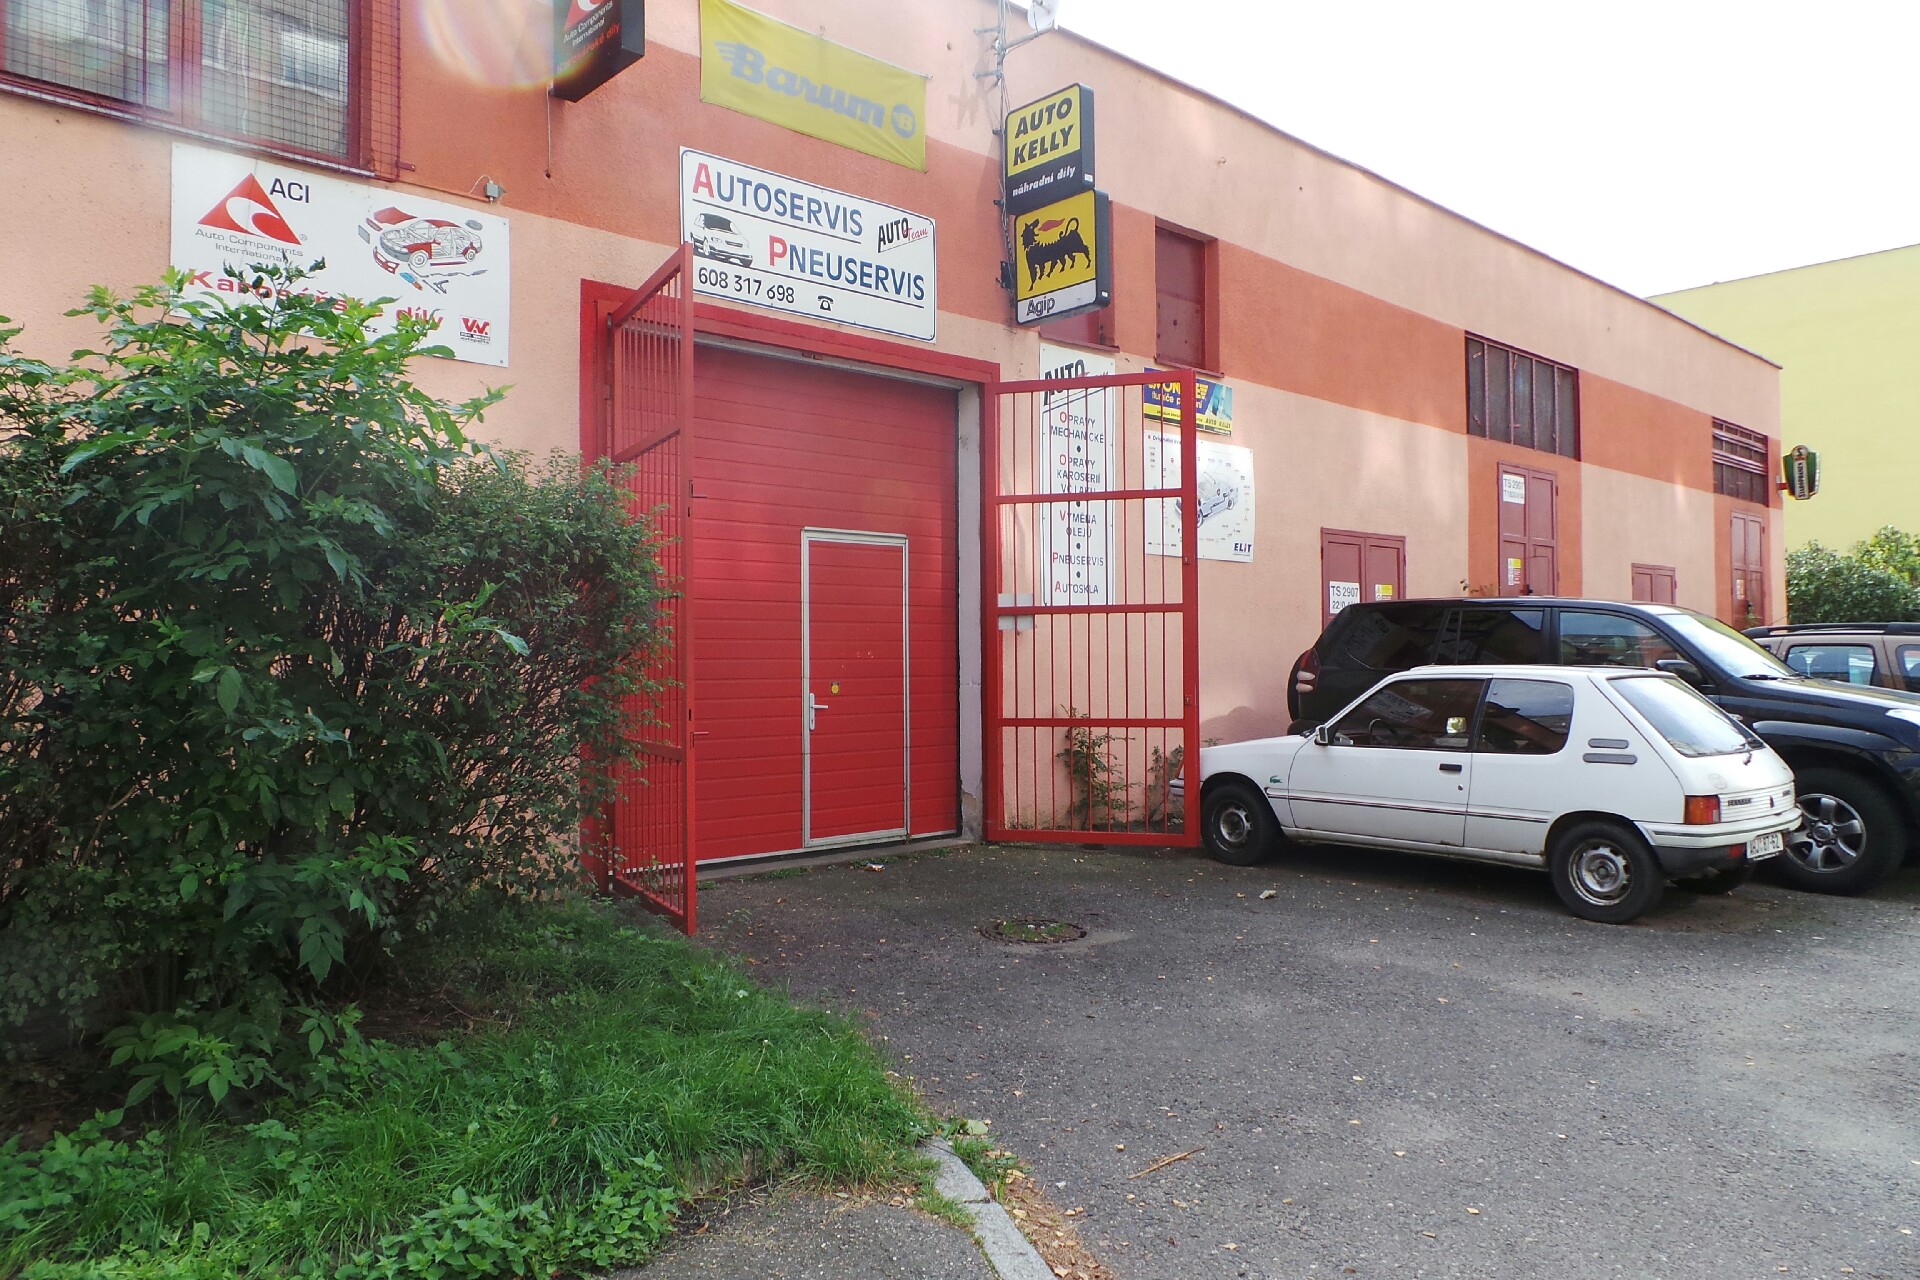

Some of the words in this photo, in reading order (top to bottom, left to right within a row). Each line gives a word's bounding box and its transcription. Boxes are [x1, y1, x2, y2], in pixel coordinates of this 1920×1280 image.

[563, 29, 579, 44] Auto
[729, 43, 886, 129] Barum
[1014, 97, 1073, 139] AUTO
[1012, 124, 1075, 167] KELLY
[269, 177, 310, 203] ACI
[1012, 170, 1054, 197] náhradní
[1057, 165, 1076, 182] díly
[692, 162, 863, 237] AUTOSERVIS
[195, 228, 225, 241] Auto
[229, 235, 304, 257] Components
[877, 217, 909, 252] AUTO
[215, 243, 285, 263] International
[768, 235, 925, 301] PNEUSERVIS
[698, 267, 729, 289] 608
[734, 274, 762, 296] 317
[766, 284, 795, 304] 698
[1025, 295, 1056, 317] Agip
[1060, 411, 1096, 428] OPRAVY
[1050, 425, 1104, 444] MECHANCKÉ
[1060, 454, 1096, 469] OPRAVY
[1504, 479, 1511, 489] TS
[1331, 585, 1341, 597] TS
[1342, 587, 1359, 598] 2907
